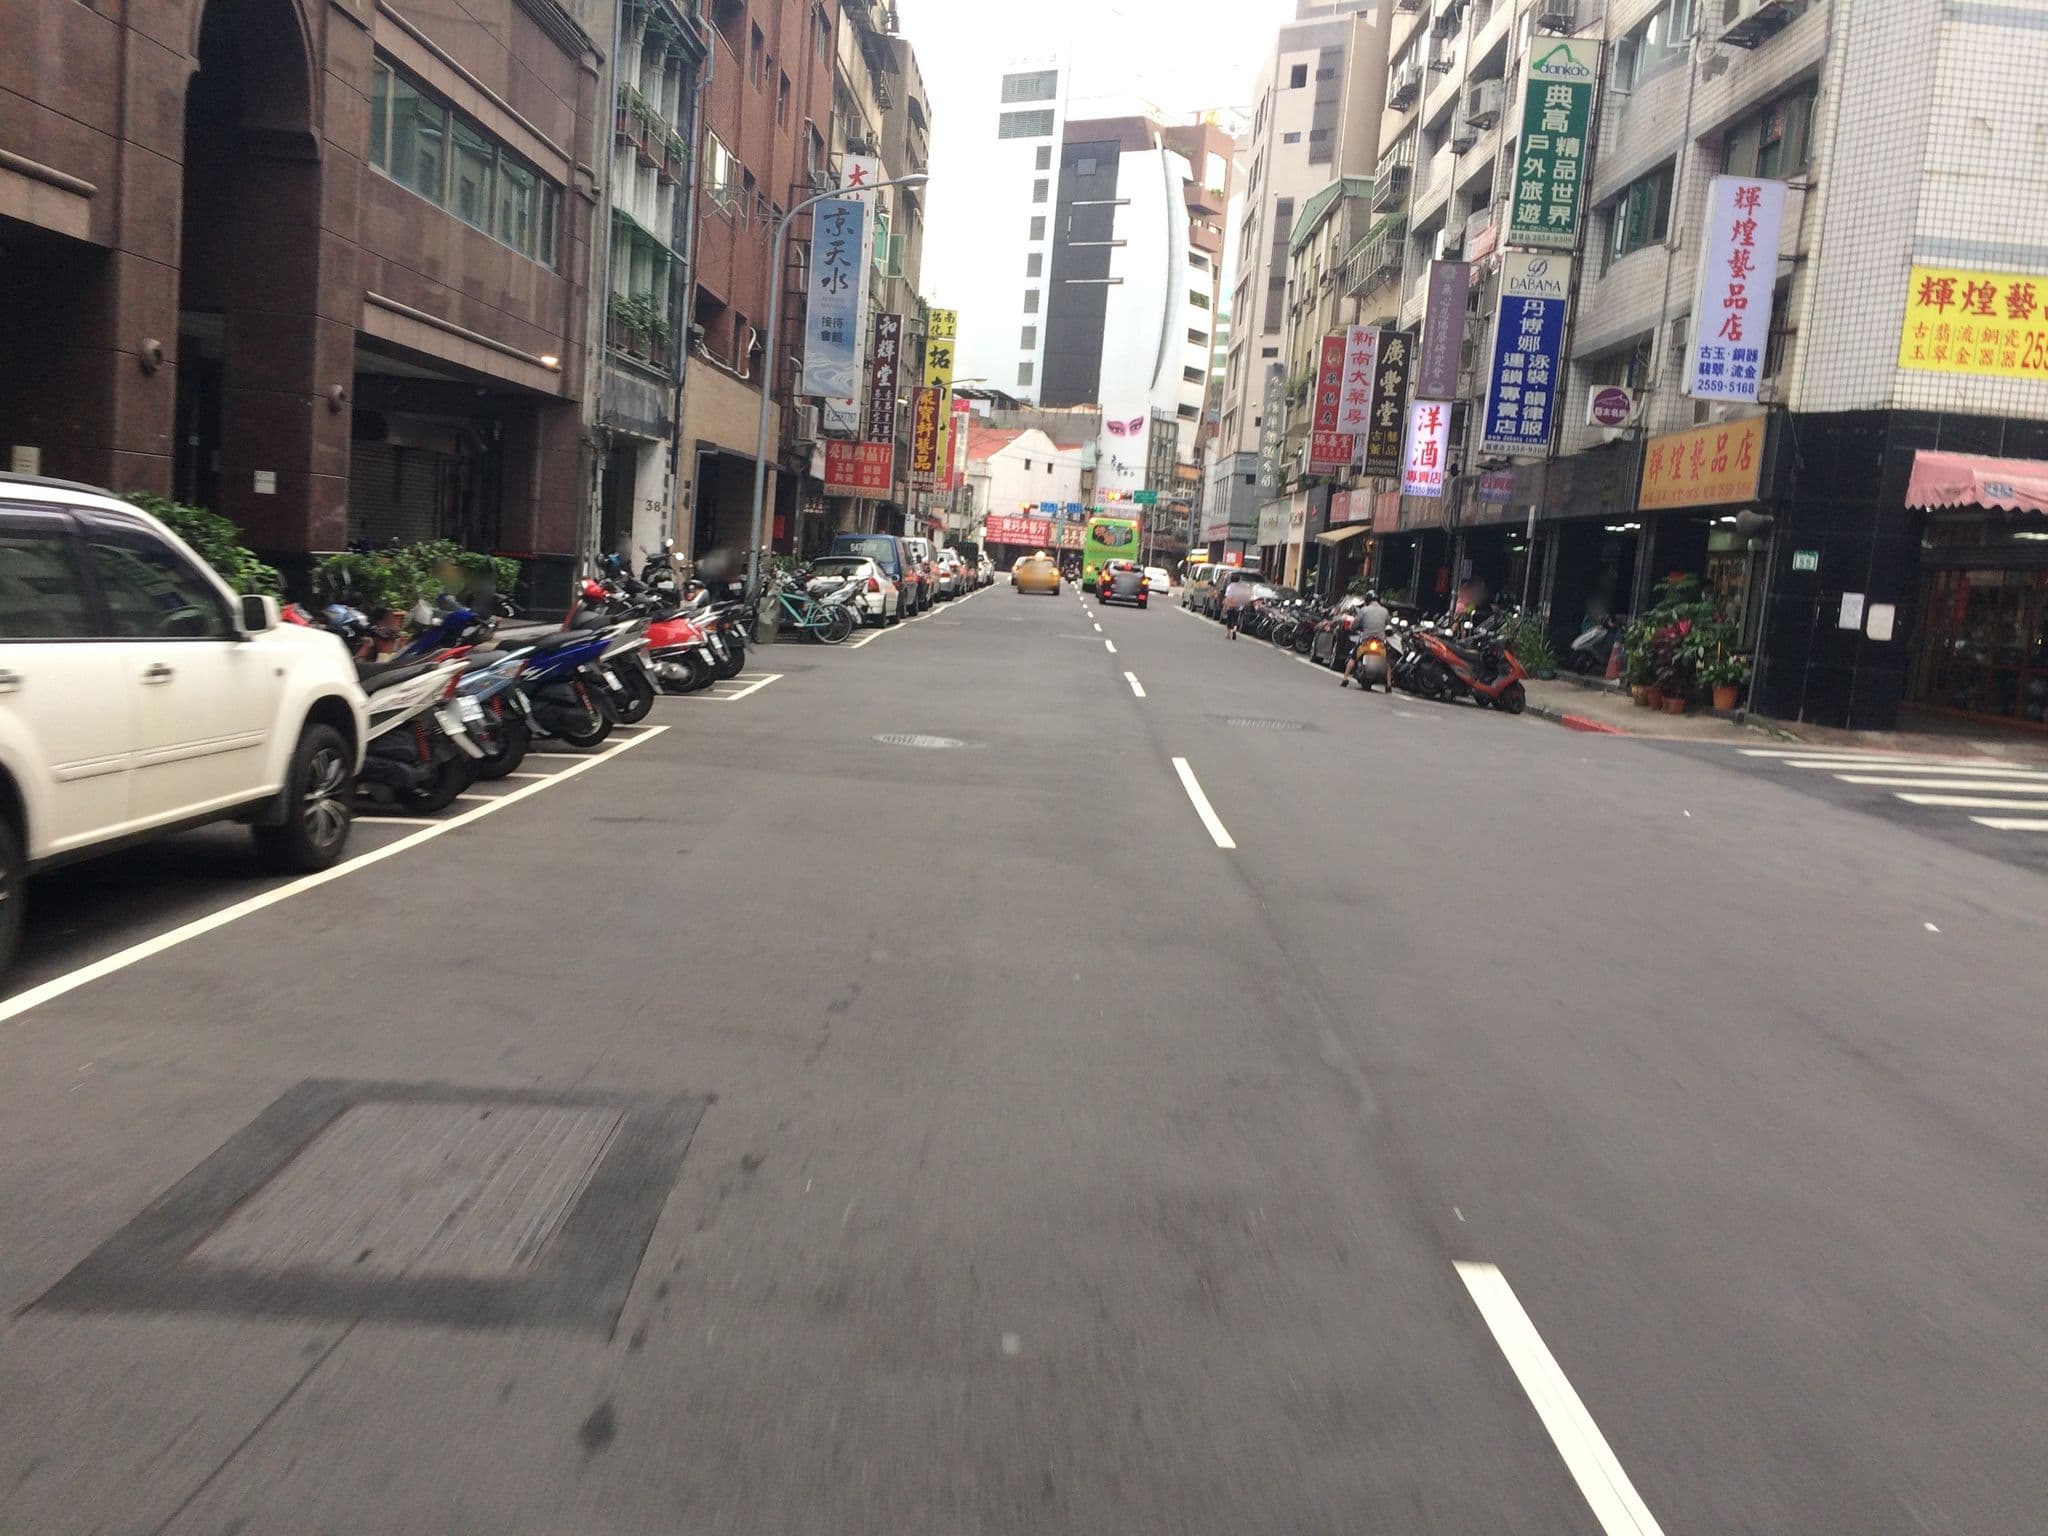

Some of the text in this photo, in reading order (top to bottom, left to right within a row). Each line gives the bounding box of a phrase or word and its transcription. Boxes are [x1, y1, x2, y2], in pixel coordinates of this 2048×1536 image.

[1539, 61, 1589, 77] dankao
[1541, 84, 1573, 133] 典高
[1517, 134, 1549, 225] 戶外旅遊
[1547, 136, 1580, 226] 精品世界
[822, 207, 854, 295] 京天水
[1718, 186, 1761, 342] 輝煌藝品店
[1510, 277, 1561, 292] DABANA
[1917, 276, 2048, 320] 輝煌藝
[877, 315, 897, 387] 和輝堂
[1517, 299, 1545, 353] 丹博娜
[1376, 338, 1405, 427] 廣豐堂
[1495, 352, 1524, 435] 連鎖專賣店
[1697, 379, 1755, 394] 2559-5168
[1412, 404, 1442, 468] 洋酒
[1649, 429, 1754, 485] 輝煌藝品店
[646, 499, 661, 512] 38
[1406, 470, 1441, 485] 專賣店
